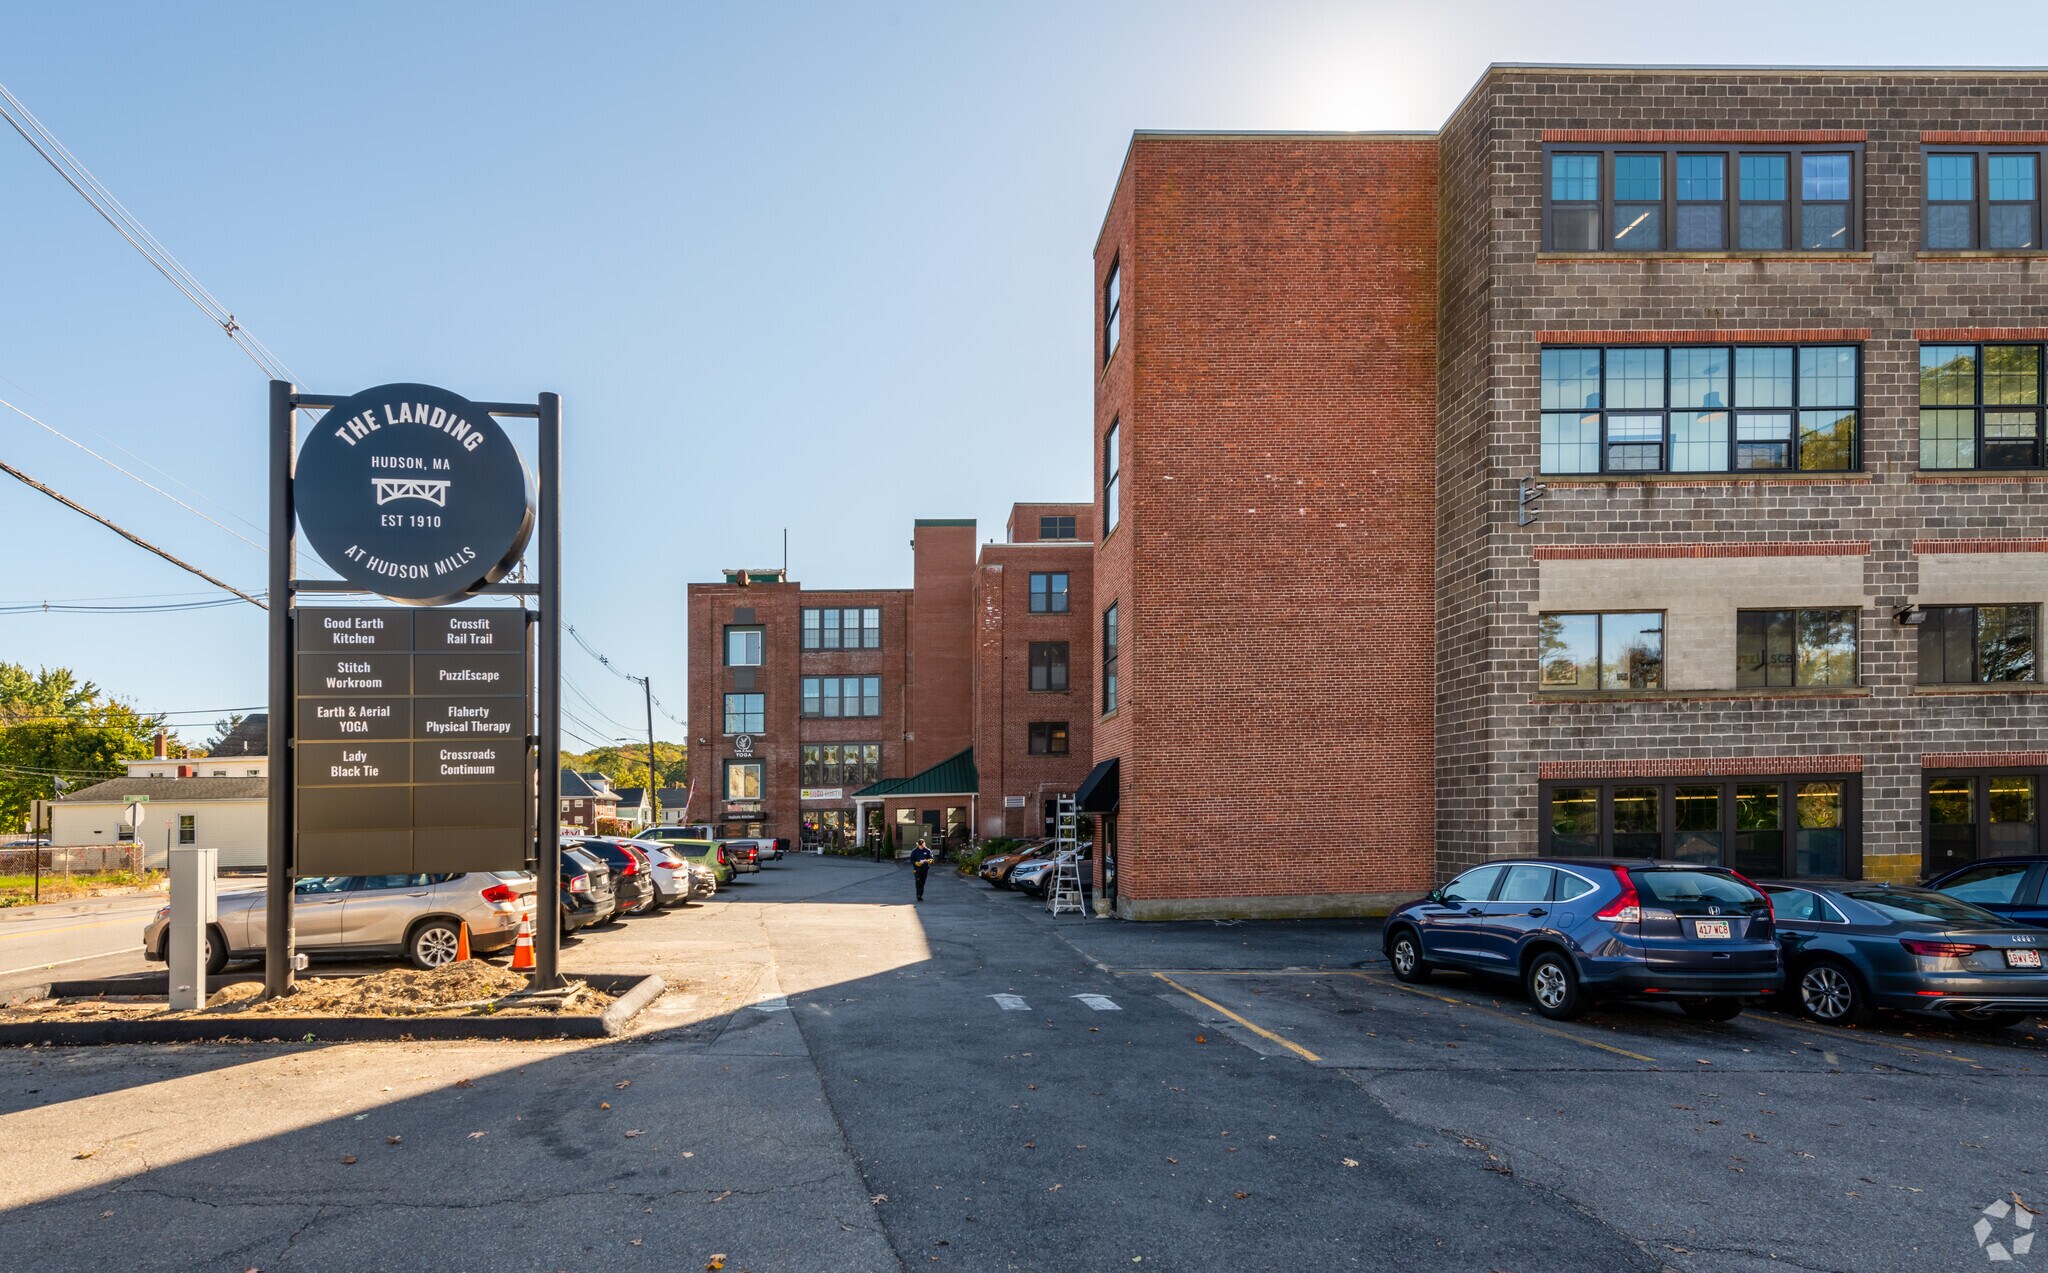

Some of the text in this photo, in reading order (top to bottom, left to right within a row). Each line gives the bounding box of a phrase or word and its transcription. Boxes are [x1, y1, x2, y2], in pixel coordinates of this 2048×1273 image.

[335, 402, 484, 452] THE LANDING
[371, 456, 450, 471] HUDSON, MA
[381, 515, 441, 528] EST 1910
[344, 545, 476, 578] AT HUDSON MILLS
[324, 617, 384, 629] Good Earth
[450, 618, 489, 630] Crossfit
[333, 633, 375, 644] Kitchen
[447, 633, 493, 644] Rail Trail
[337, 662, 371, 673] Stitch
[439, 669, 500, 682] PuzzlEscape
[326, 677, 382, 688] Workroom
[317, 706, 390, 718] Earth & Aerial
[448, 706, 489, 719] Flaherty
[339, 721, 368, 732] YOGA
[426, 721, 511, 734] Physical Therapy
[343, 750, 367, 764] Lady
[440, 749, 496, 761] Crossroads
[331, 765, 379, 777] Black Tie
[440, 763, 495, 775] Continuum
[1699, 925, 1729, 934] 417 WC8
